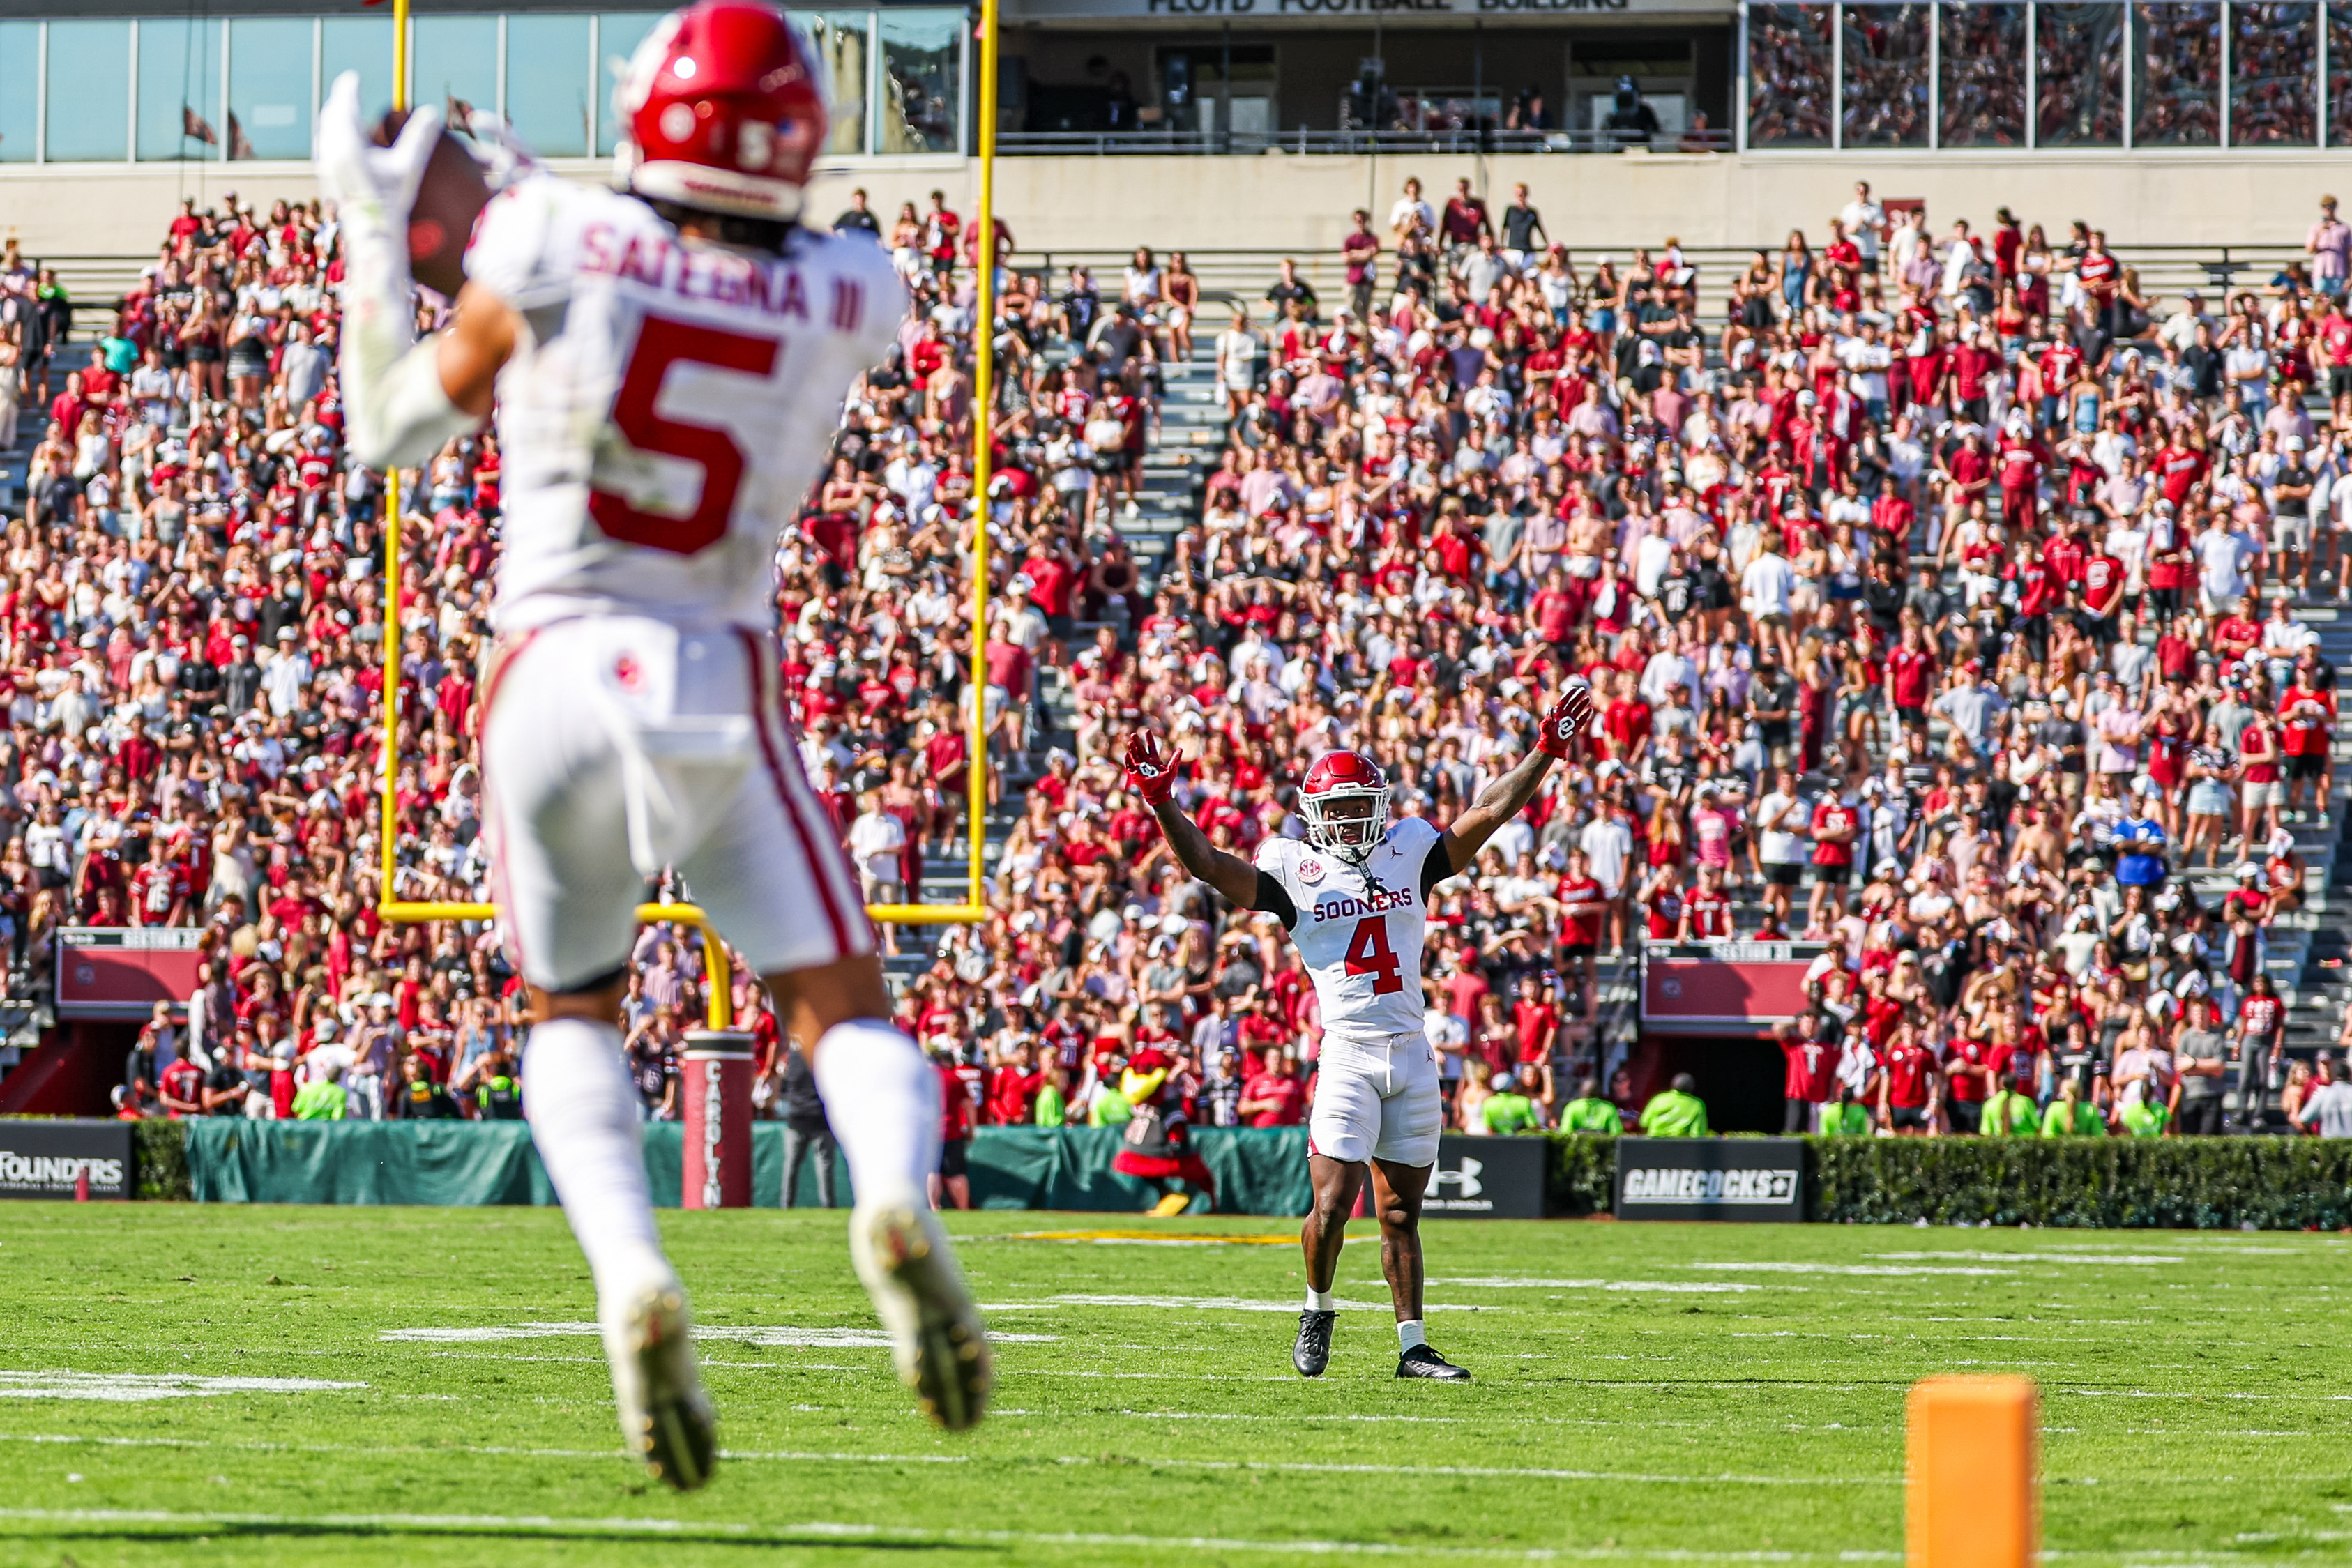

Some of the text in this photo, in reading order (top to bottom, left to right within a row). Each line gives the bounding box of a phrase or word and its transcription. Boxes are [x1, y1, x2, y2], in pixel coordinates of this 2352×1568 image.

[588, 310, 784, 556] 5
[1300, 860, 1321, 876] SEC
[1313, 888, 1413, 922] SOONERS
[1344, 915, 1404, 996] 4
[703, 1060, 722, 1208] CAROLIN
